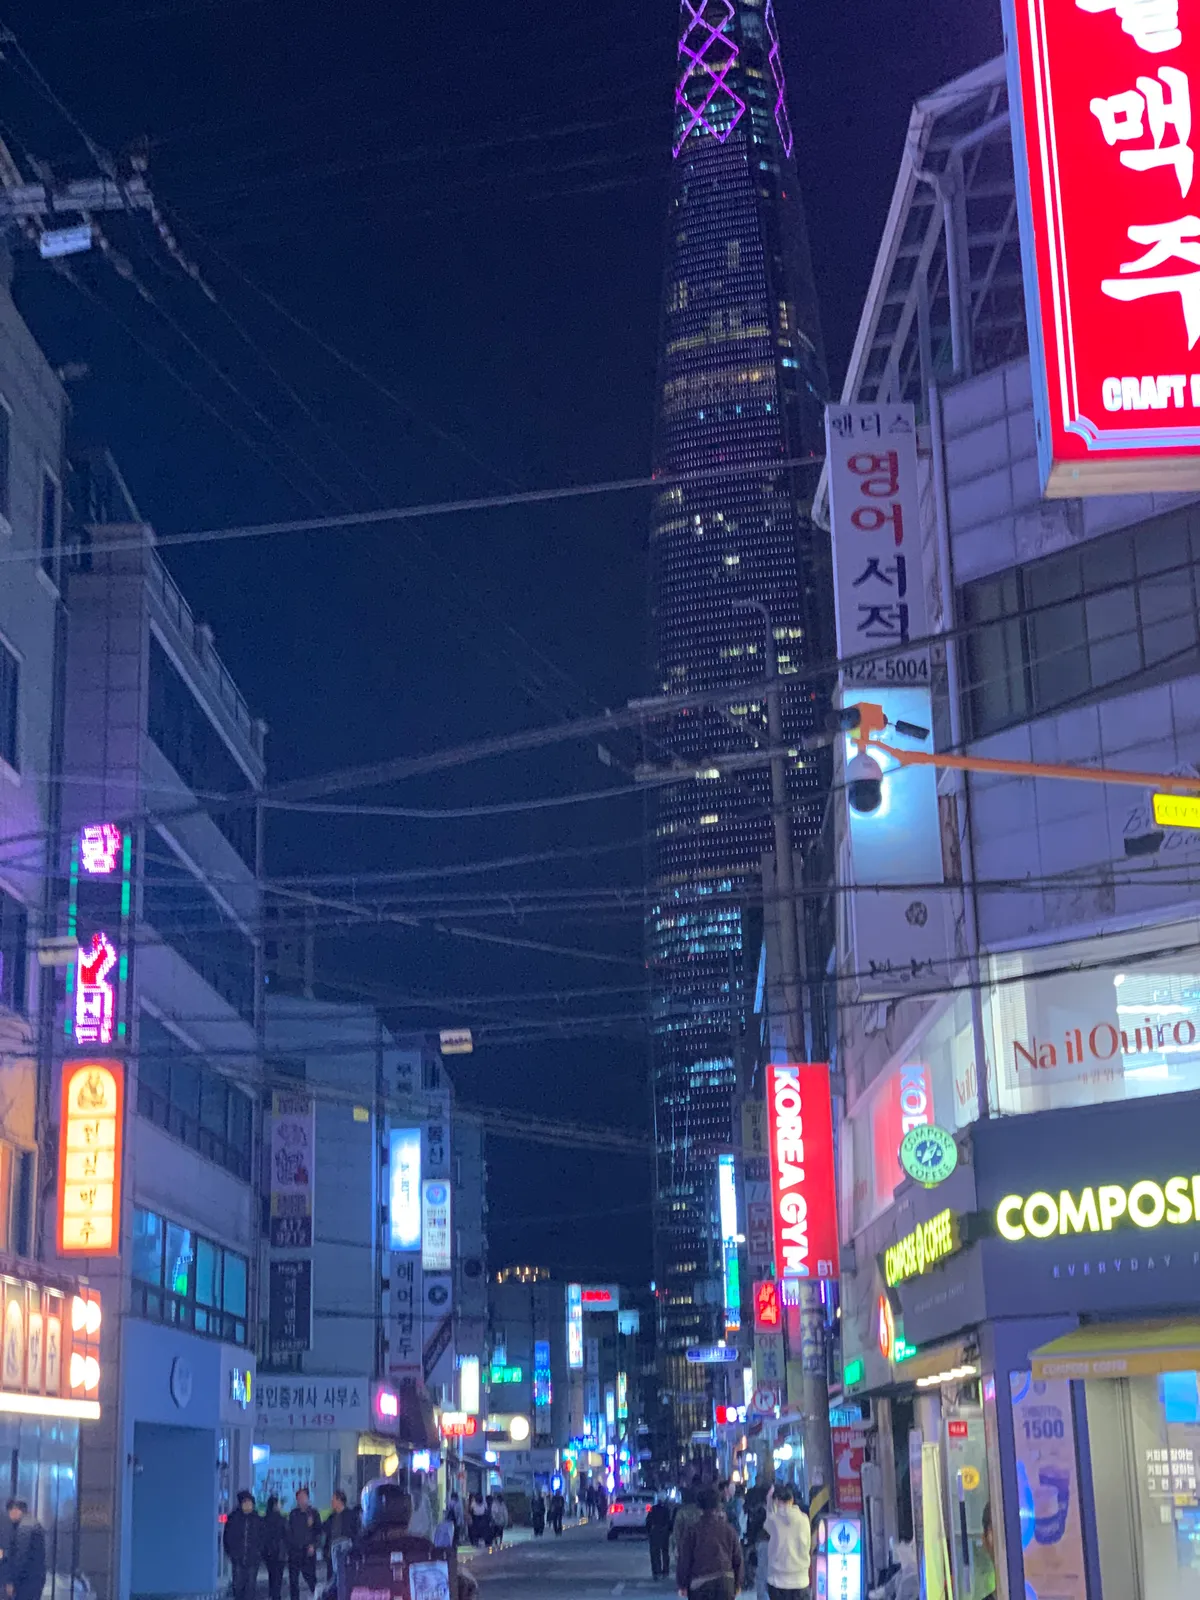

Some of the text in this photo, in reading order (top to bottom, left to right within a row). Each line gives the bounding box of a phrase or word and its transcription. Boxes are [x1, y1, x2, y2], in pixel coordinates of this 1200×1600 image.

[1102, 375, 1185, 412] CRAFT
[847, 451, 910, 644] 영어서적
[904, 1128, 954, 1152] COMPOSE
[773, 1066, 810, 1277] KOREA GYM
[909, 1163, 951, 1180] COFFEE
[885, 1207, 953, 1287] COMPOSE COFFEE
[1042, 1359, 1127, 1375] COMPOSE COFFEE
[1023, 1420, 1064, 1440] 1500
